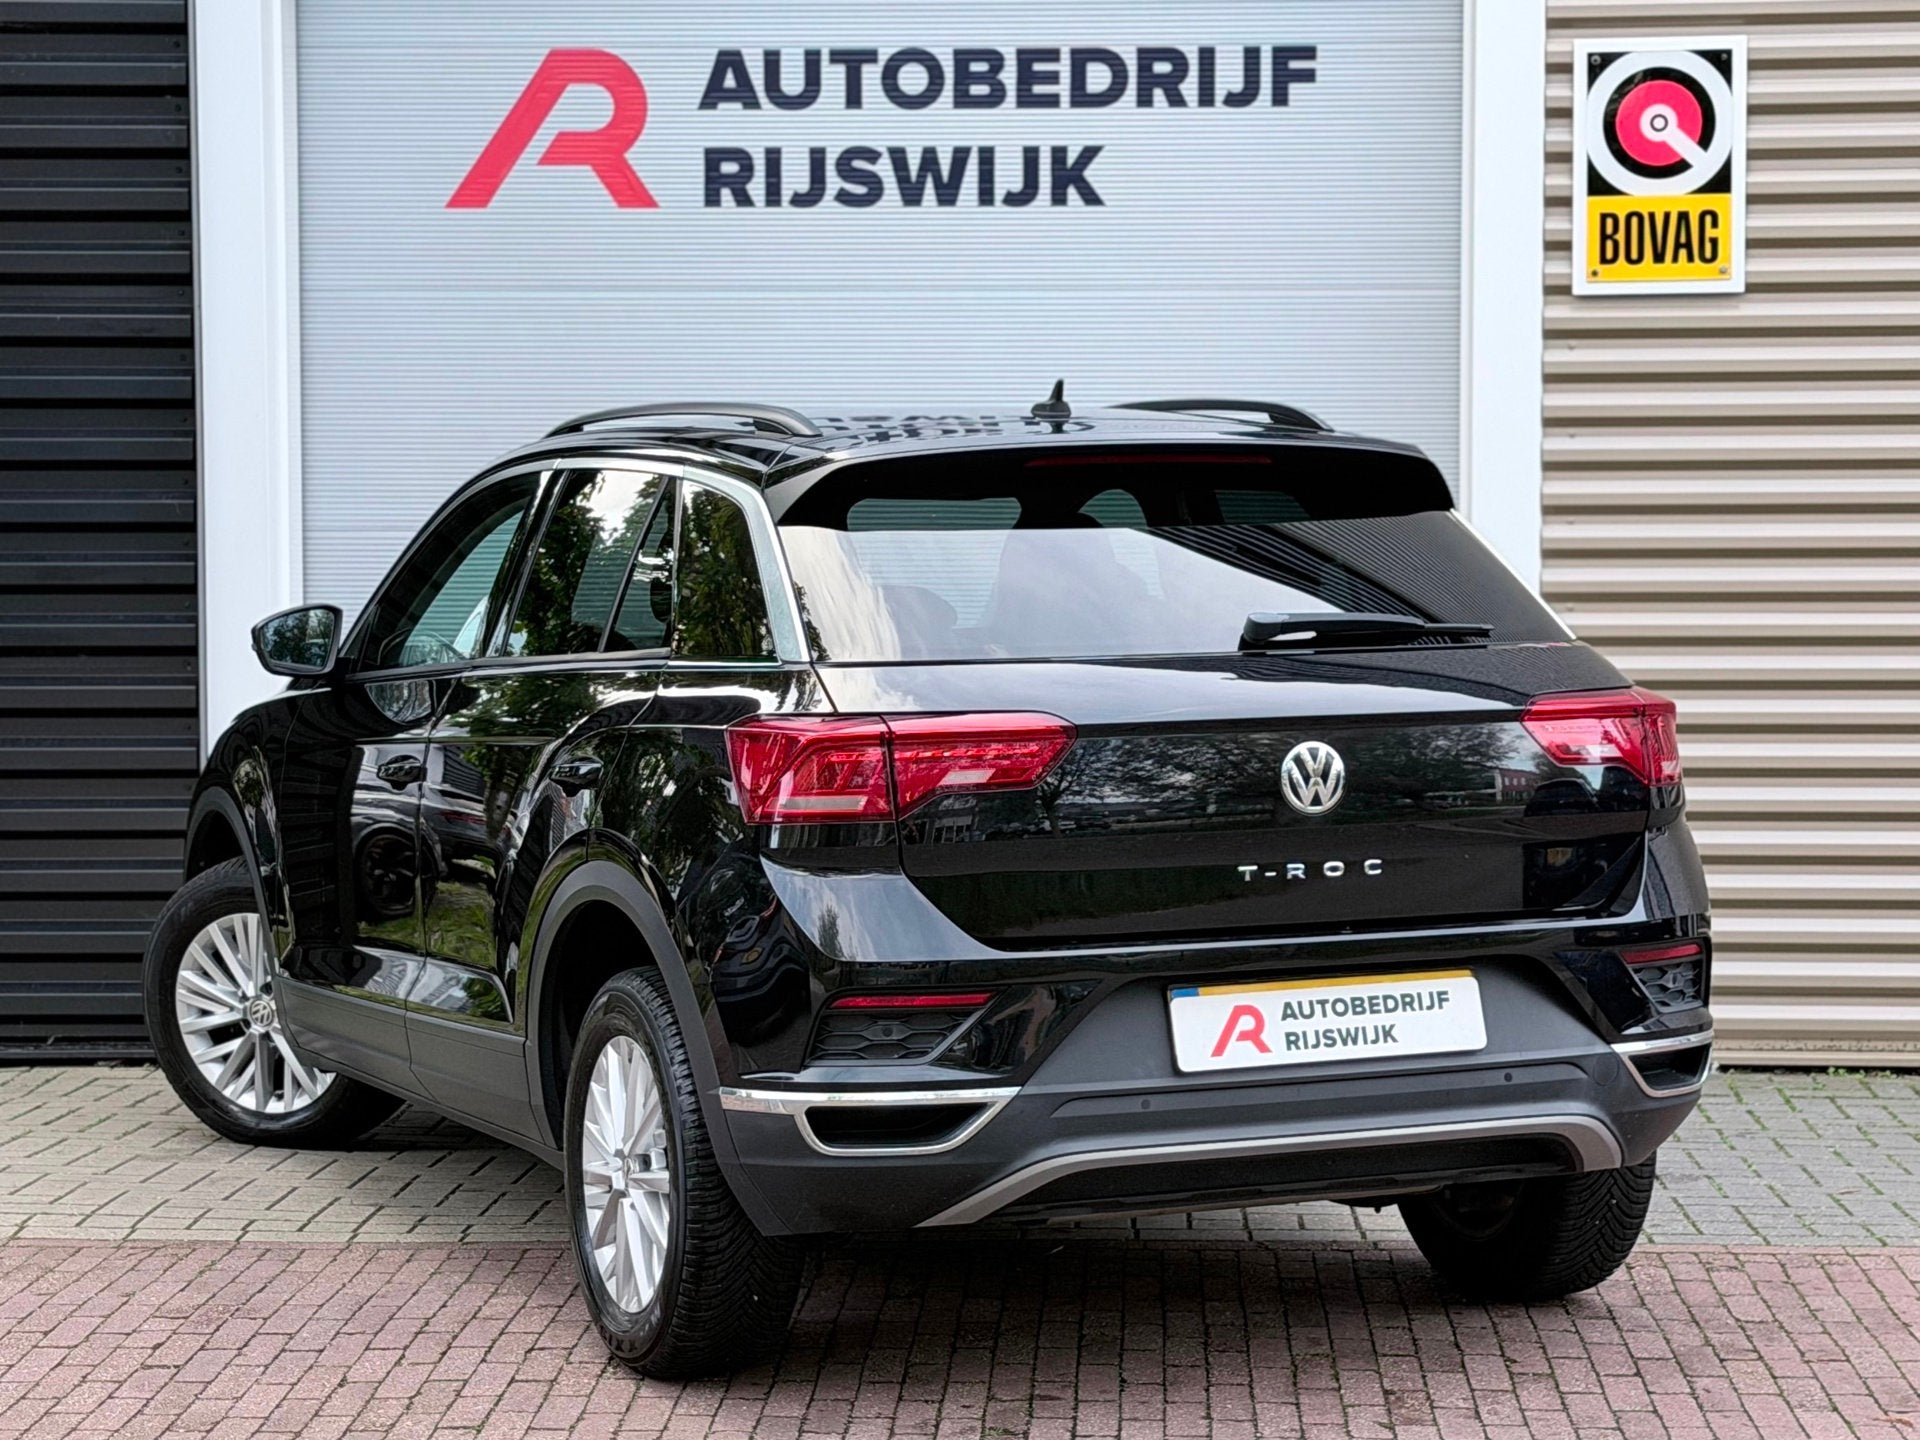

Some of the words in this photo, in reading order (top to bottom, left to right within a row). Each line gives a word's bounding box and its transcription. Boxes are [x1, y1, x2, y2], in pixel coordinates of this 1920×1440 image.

[699, 45, 1317, 110] AUTOBEDRIJF
[704, 145, 1104, 208] RIJSWIJK
[1599, 210, 1719, 265] BOVAG
[1281, 990, 1449, 1021] AUTOBEDRIJF
[1285, 1024, 1398, 1051] RIJSWIJK
